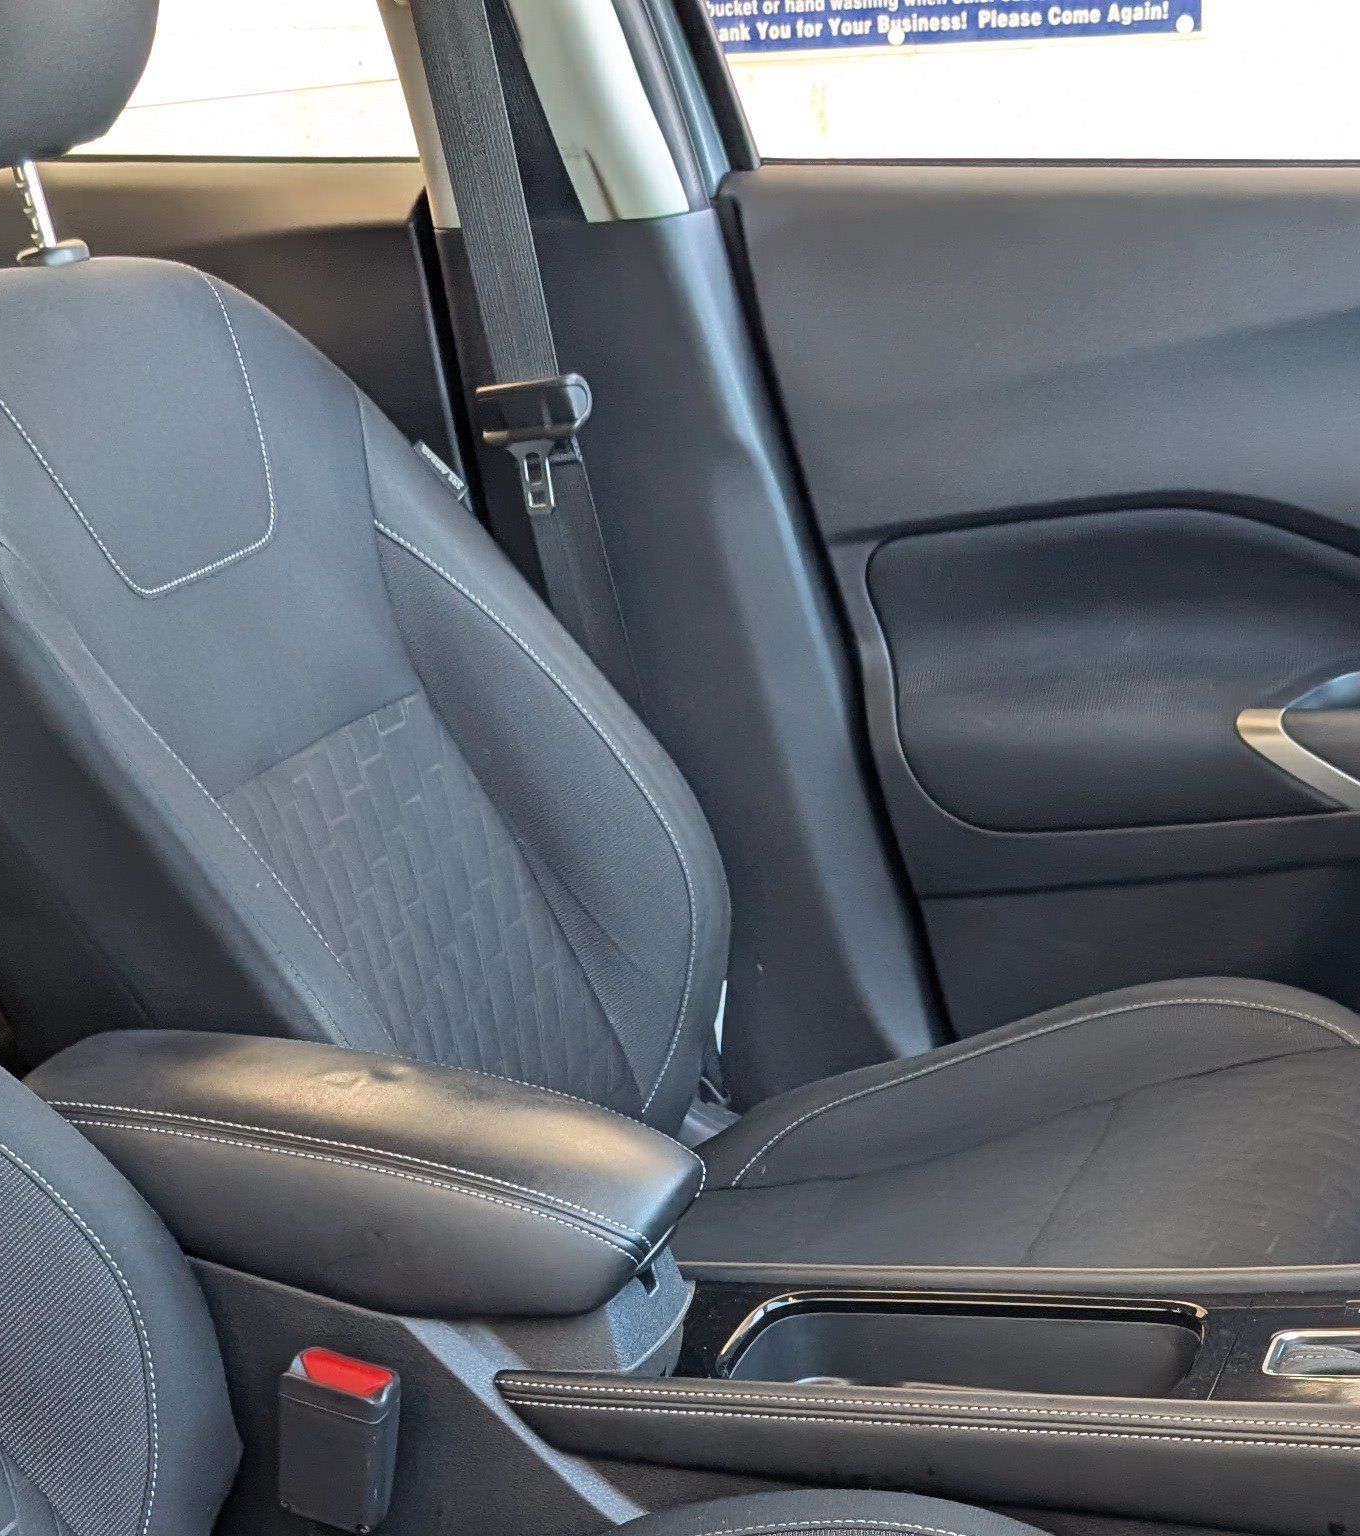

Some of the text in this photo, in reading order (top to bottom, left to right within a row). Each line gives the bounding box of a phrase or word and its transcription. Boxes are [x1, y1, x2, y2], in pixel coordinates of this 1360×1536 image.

[716, 1, 1169, 42] ank You for Your Business! Please Come Again!
[763, 1, 780, 15] or
